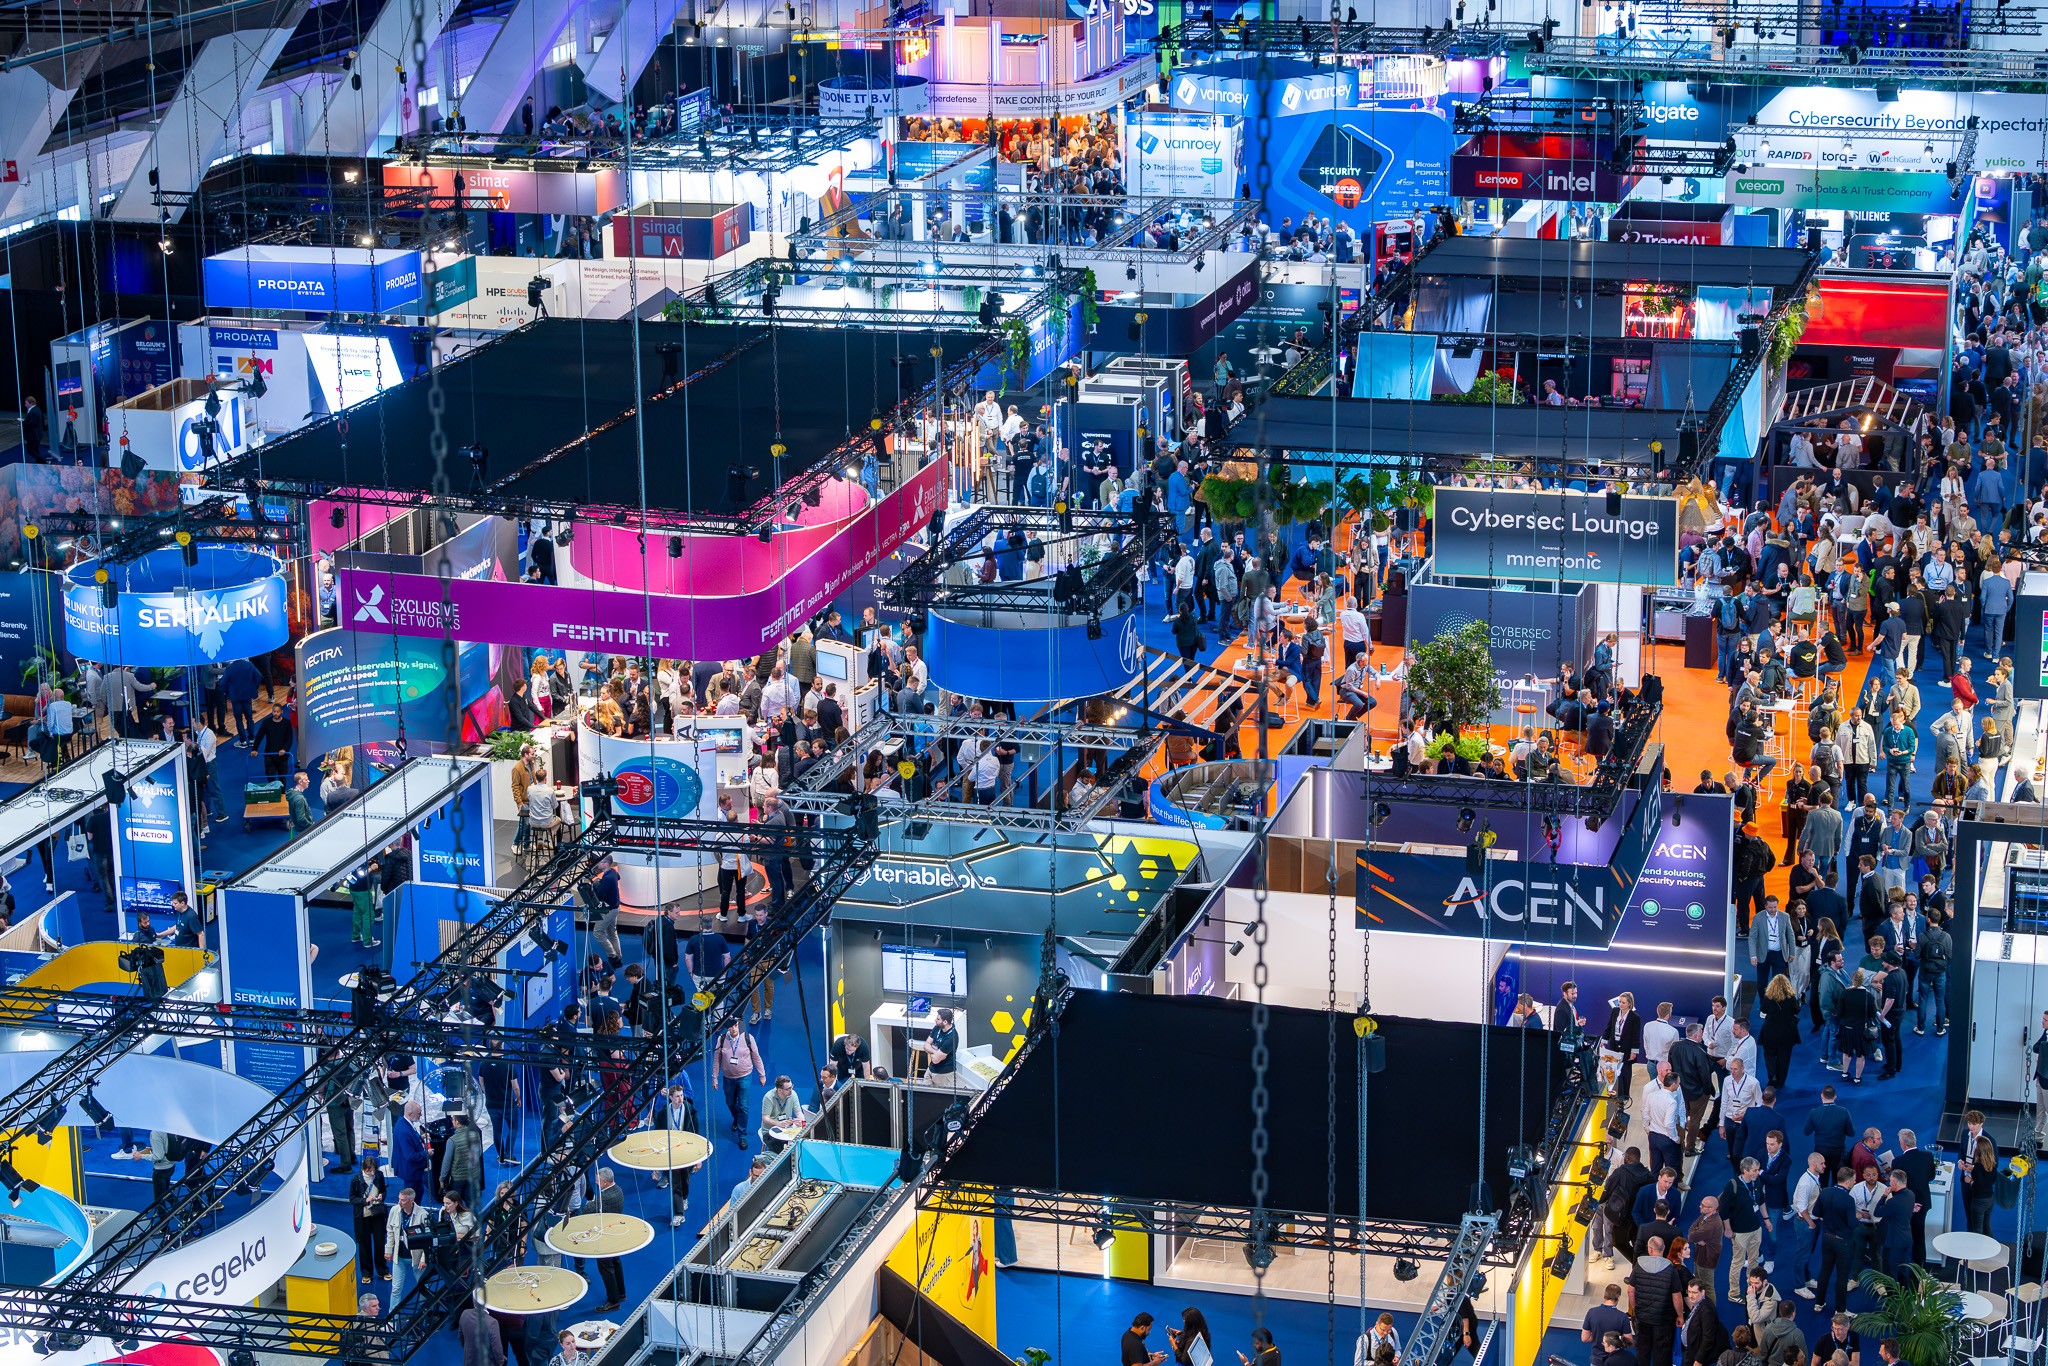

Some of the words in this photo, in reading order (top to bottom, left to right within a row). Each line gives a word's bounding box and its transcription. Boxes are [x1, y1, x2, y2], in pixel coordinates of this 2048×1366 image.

[854, 93, 867, 104] IT
[994, 96, 1018, 105] TAKE
[1021, 94, 1063, 105] CONTROL
[1064, 93, 1075, 102] OF
[1076, 90, 1095, 101] YOUR
[1200, 87, 1250, 109] vanroey
[1304, 82, 1352, 101] vanroey
[927, 94, 978, 105] yberdefense
[1789, 110, 1901, 130] Cybersecurity
[1905, 114, 1966, 130] Beyond
[1163, 139, 1221, 154] vanroey
[1153, 164, 1195, 172] TheCollective
[1985, 157, 2025, 168] yubico
[1320, 166, 1361, 176] SECURITY
[469, 172, 510, 188] simac
[1479, 174, 1519, 186] Lenovo
[1547, 169, 1596, 192] intel
[1739, 181, 1781, 192] veeam
[1320, 185, 1340, 194] HPE
[1796, 183, 1813, 194] The
[1815, 184, 1838, 194] Data
[1841, 185, 1848, 194] &
[1850, 185, 1861, 195] AI
[1863, 186, 1885, 196] Trust
[1887, 187, 1933, 199] Company
[642, 219, 683, 234] simac
[723, 212, 739, 228] simac
[591, 267, 608, 275] design,
[258, 279, 324, 291] PRODATA
[386, 271, 417, 291] PRODATA
[445, 280, 456, 289] Brand
[445, 283, 466, 298] Compliance
[486, 288, 507, 297] HPE
[215, 332, 272, 343] PRODATA
[1852, 355, 1875, 363] TrendAI
[344, 368, 373, 377] HPE
[1451, 506, 1565, 533] Cybersec
[1571, 512, 1660, 540] Lounge
[881, 532, 898, 549] VECTRA
[1506, 552, 1602, 571] mnemonic
[829, 575, 841, 594] jamf
[869, 574, 890, 586] The
[807, 589, 824, 609] DRATA
[71, 602, 88, 615] LINK
[89, 606, 104, 618] TO
[138, 594, 270, 628] SERTALINK
[391, 597, 460, 618] EXCLUSIVE
[0, 621, 28, 631] Serenity.
[69, 615, 120, 636] RESILIENCE
[390, 615, 461, 631] NETWORKS
[761, 598, 805, 643] FORTINET
[552, 622, 669, 647] FORTINET
[1490, 625, 1552, 640] CYBERSEC
[1490, 638, 1537, 651] EUROPE
[304, 646, 343, 670] VECTRA
[321, 666, 351, 680] network
[351, 661, 410, 672] observability,
[411, 661, 439, 671] signal,
[313, 681, 333, 692] control
[343, 674, 352, 682] AI
[353, 670, 378, 681] speed
[366, 748, 400, 757] VECTRA
[1163, 810, 1174, 822] the
[140, 831, 168, 839] ACTION
[1655, 843, 1707, 861] ACEN
[423, 853, 481, 867] SERTALINK
[873, 864, 955, 888] tenable
[958, 874, 998, 889] one
[1663, 869, 1706, 879] solutions,
[1639, 877, 1674, 887] security
[1676, 877, 1706, 888] needs.
[1443, 876, 1603, 931] ACEN
[234, 992, 298, 1007] SERTALINK
[175, 1235, 267, 1302] cegeka
